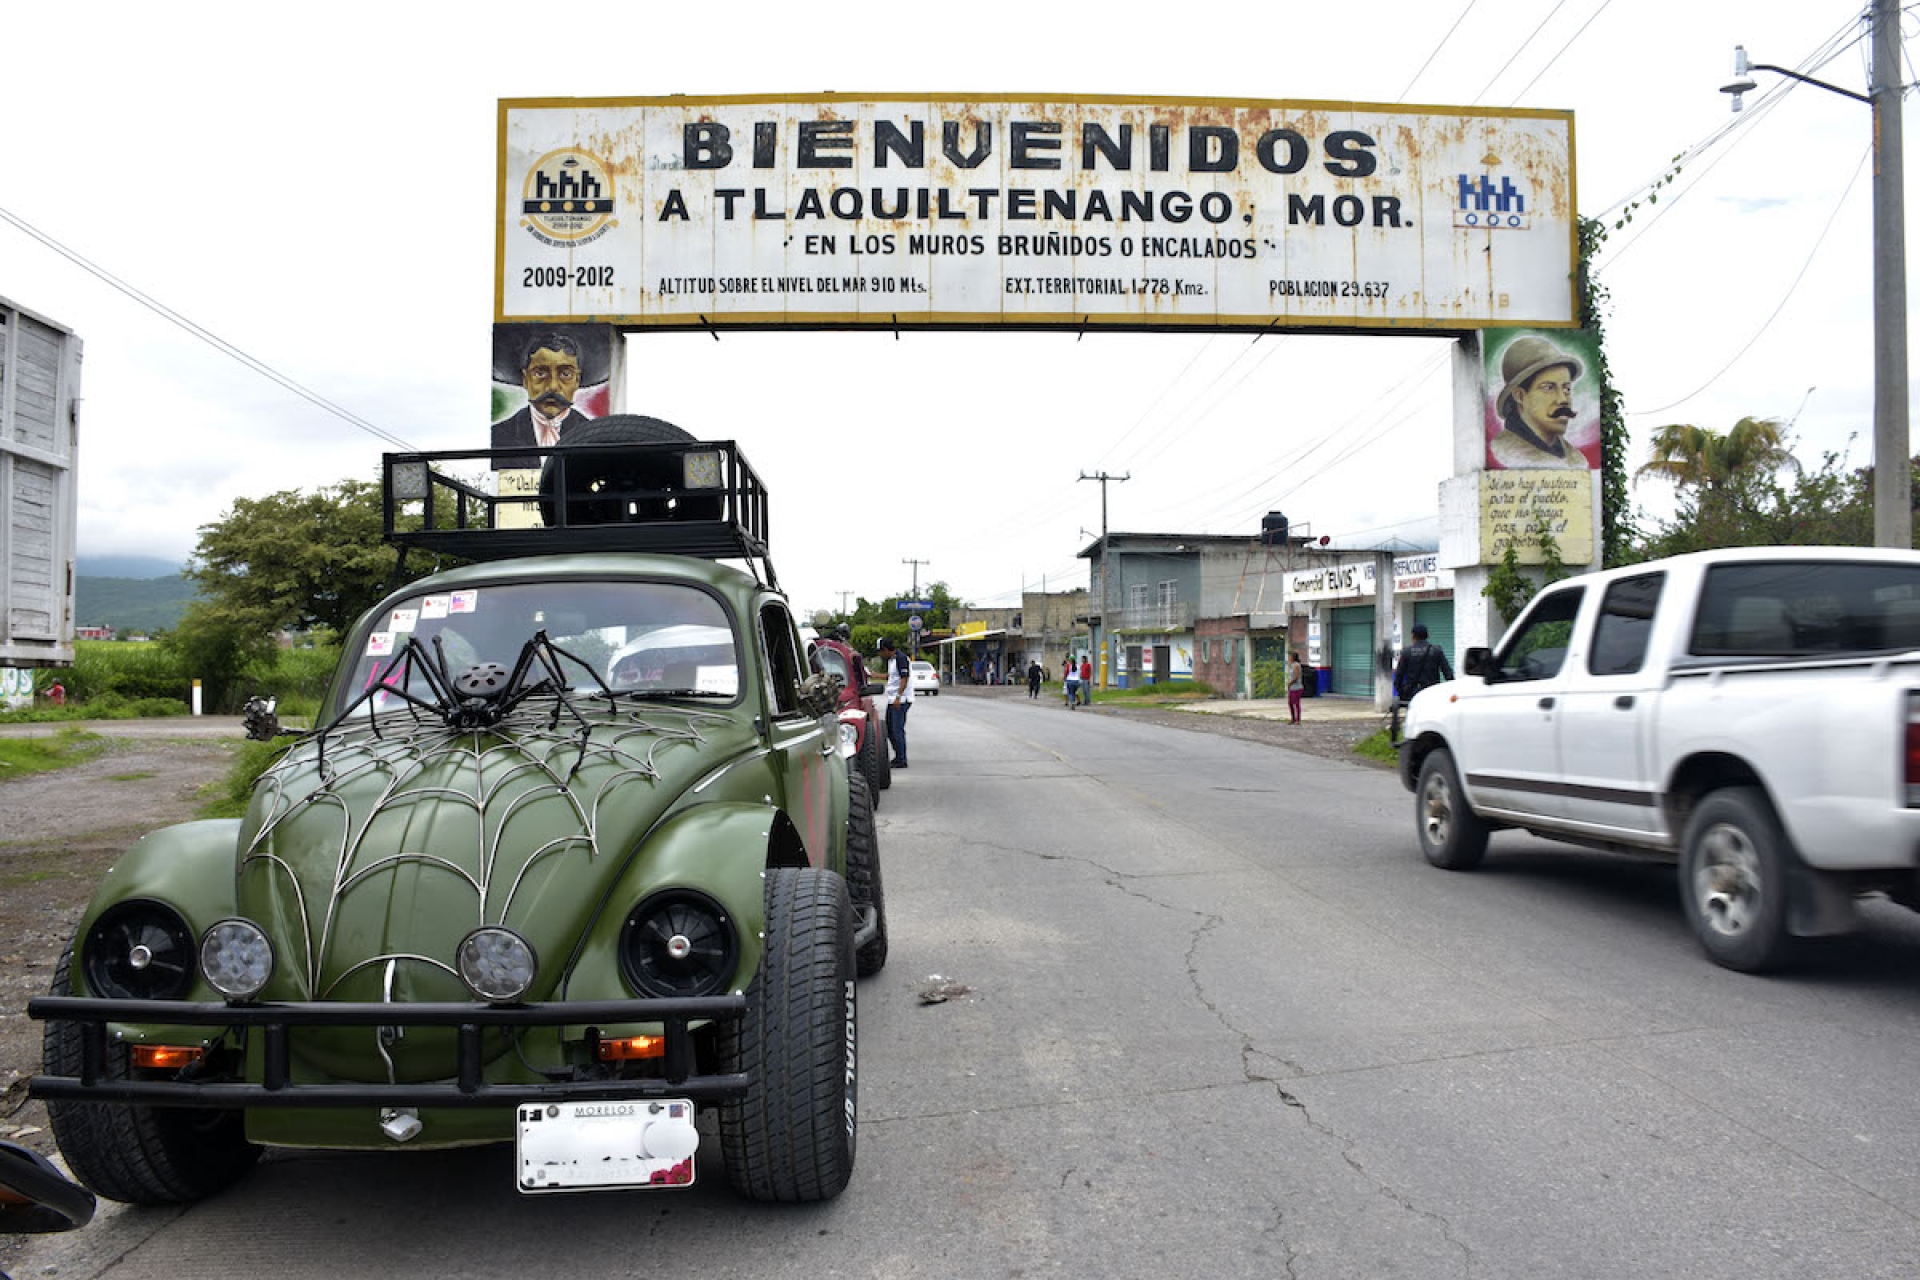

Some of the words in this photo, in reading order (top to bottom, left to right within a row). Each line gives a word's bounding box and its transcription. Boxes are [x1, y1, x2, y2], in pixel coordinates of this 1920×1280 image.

[683, 120, 1377, 178] BIENVENIDOS
[658, 189, 690, 222] A
[1288, 193, 1414, 228] MOR.
[850, 234, 896, 256] LOS
[909, 234, 985, 256] MUROS
[997, 231, 1112, 257] BRUÑIDOS
[1120, 236, 1134, 257] O
[522, 266, 615, 288] 2009-2012
[658, 276, 716, 295] ALTITUD
[719, 276, 759, 294] SOBRE
[761, 276, 775, 294] EL
[777, 276, 814, 293] NIVEL
[816, 276, 840, 293] DEL
[842, 276, 868, 293] MAR
[871, 276, 897, 293] 910
[900, 276, 928, 294] Mts.
[1132, 277, 1171, 296] 1.778
[1269, 279, 1338, 297] POBLACION
[1341, 281, 1390, 299] 29.637
[844, 980, 857, 1086] RADIAL
[574, 1105, 636, 1117] MORELOS
